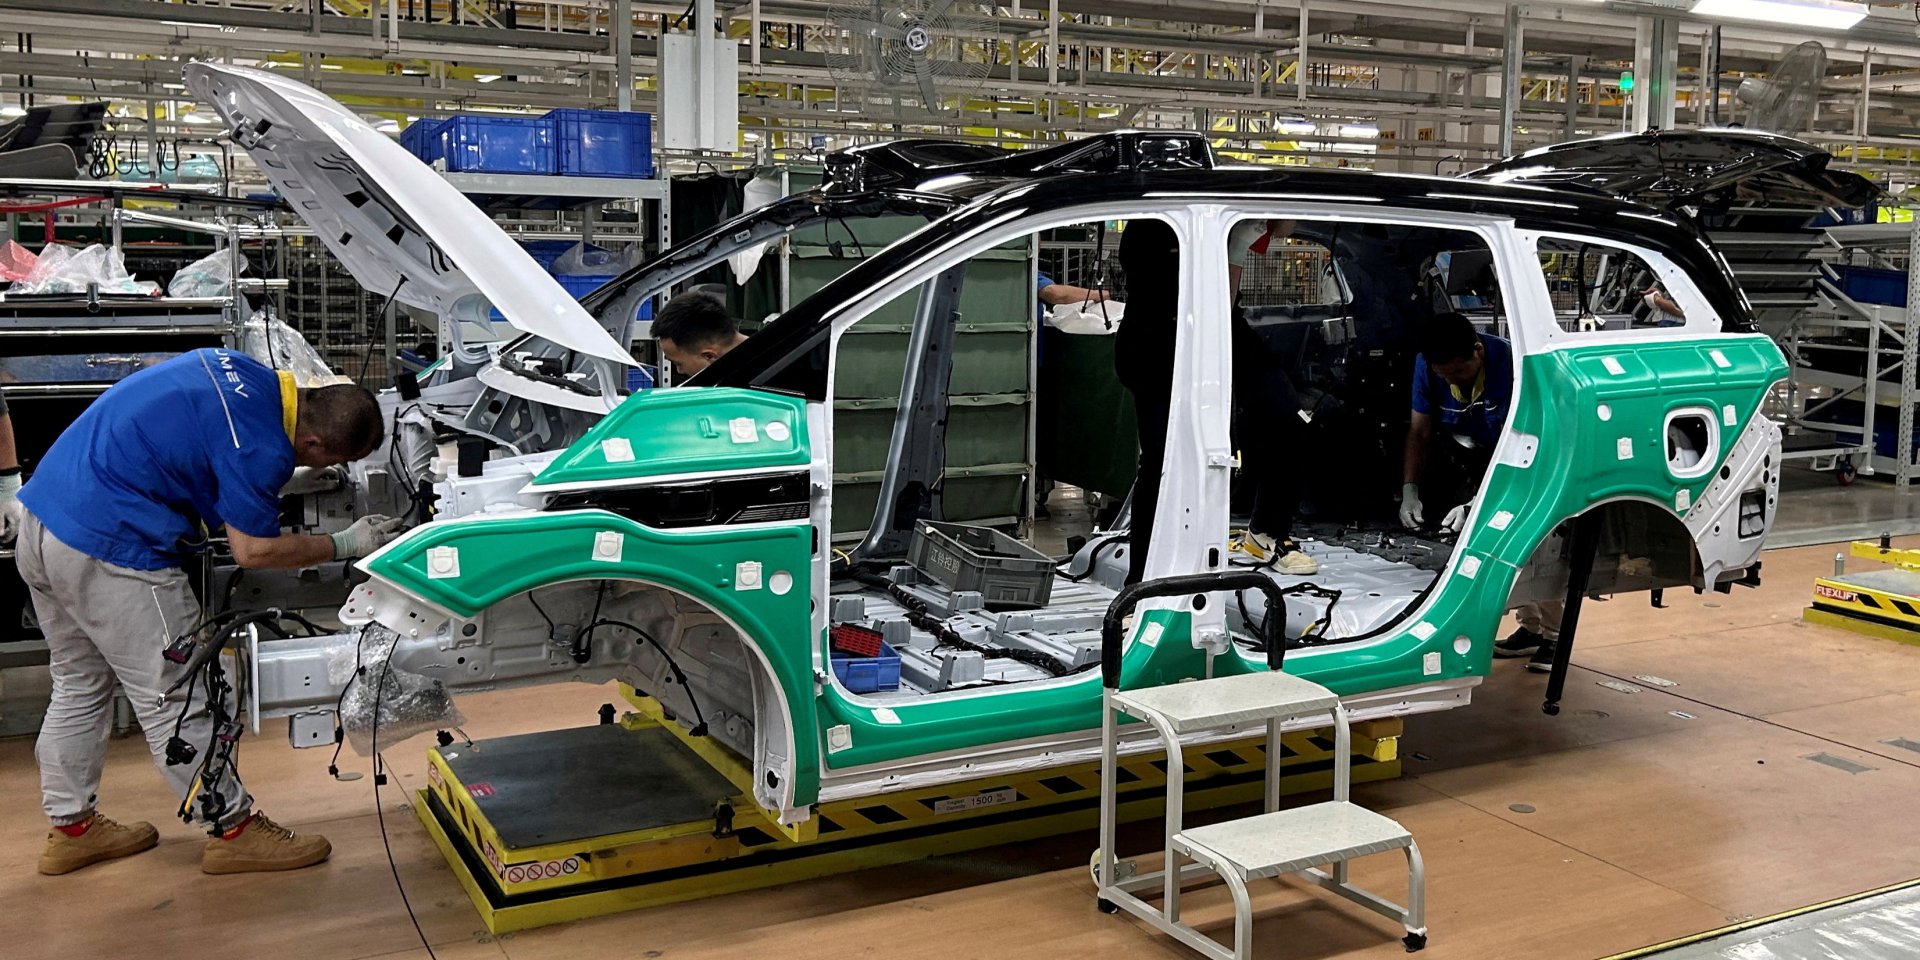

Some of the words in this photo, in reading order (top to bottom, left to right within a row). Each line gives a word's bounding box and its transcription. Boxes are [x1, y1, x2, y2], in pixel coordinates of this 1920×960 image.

[214, 348, 249, 398] JMEV
[1815, 585, 1858, 602] FLEXLIFT
[971, 795, 993, 806] 1500
